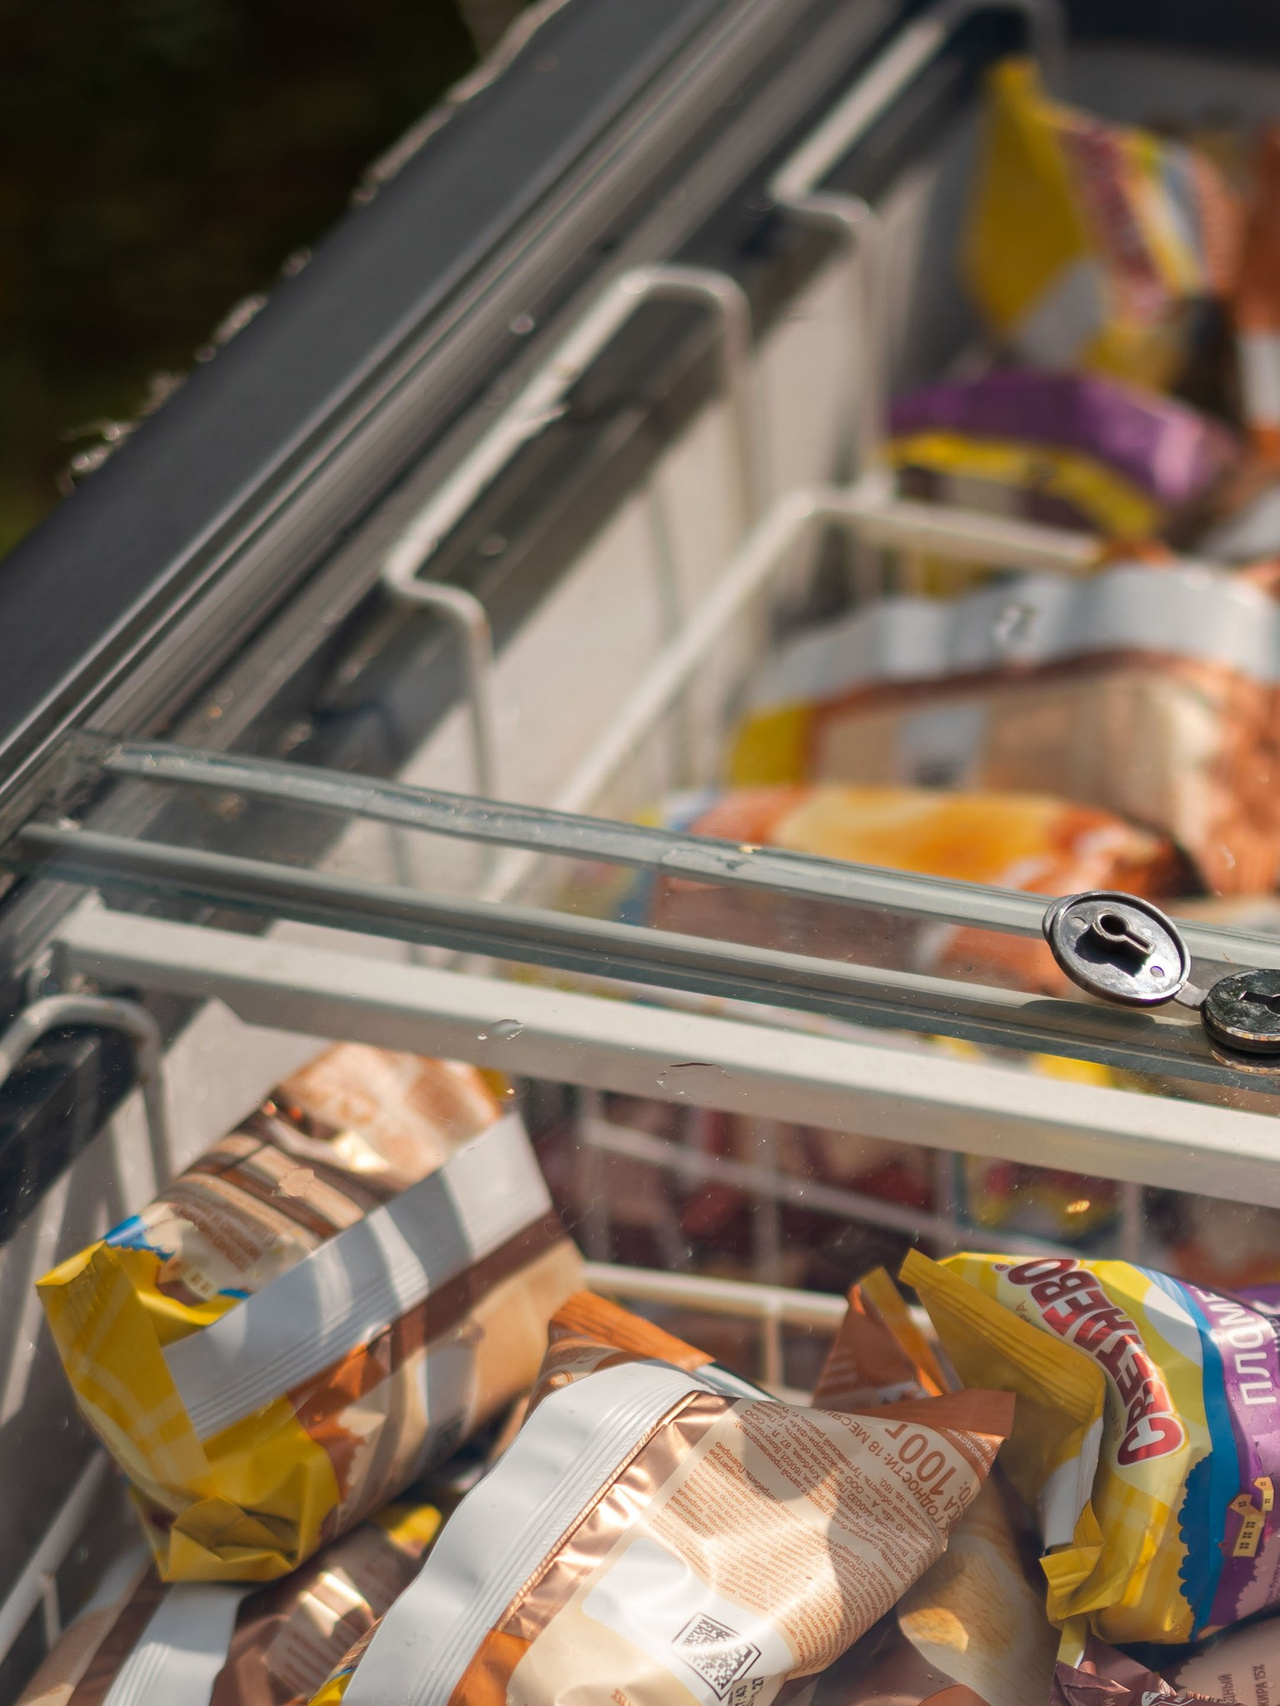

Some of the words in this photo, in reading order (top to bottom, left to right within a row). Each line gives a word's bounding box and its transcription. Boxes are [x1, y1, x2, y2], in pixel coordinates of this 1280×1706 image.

[1010, 1264, 1183, 1464] СВЕТАЕВО
[866, 1437, 886, 1459] 18
[894, 1429, 960, 1499] 100
[880, 1450, 946, 1526] ГОДНОСТИ:
[1250, 1664, 1267, 1679] 15%
